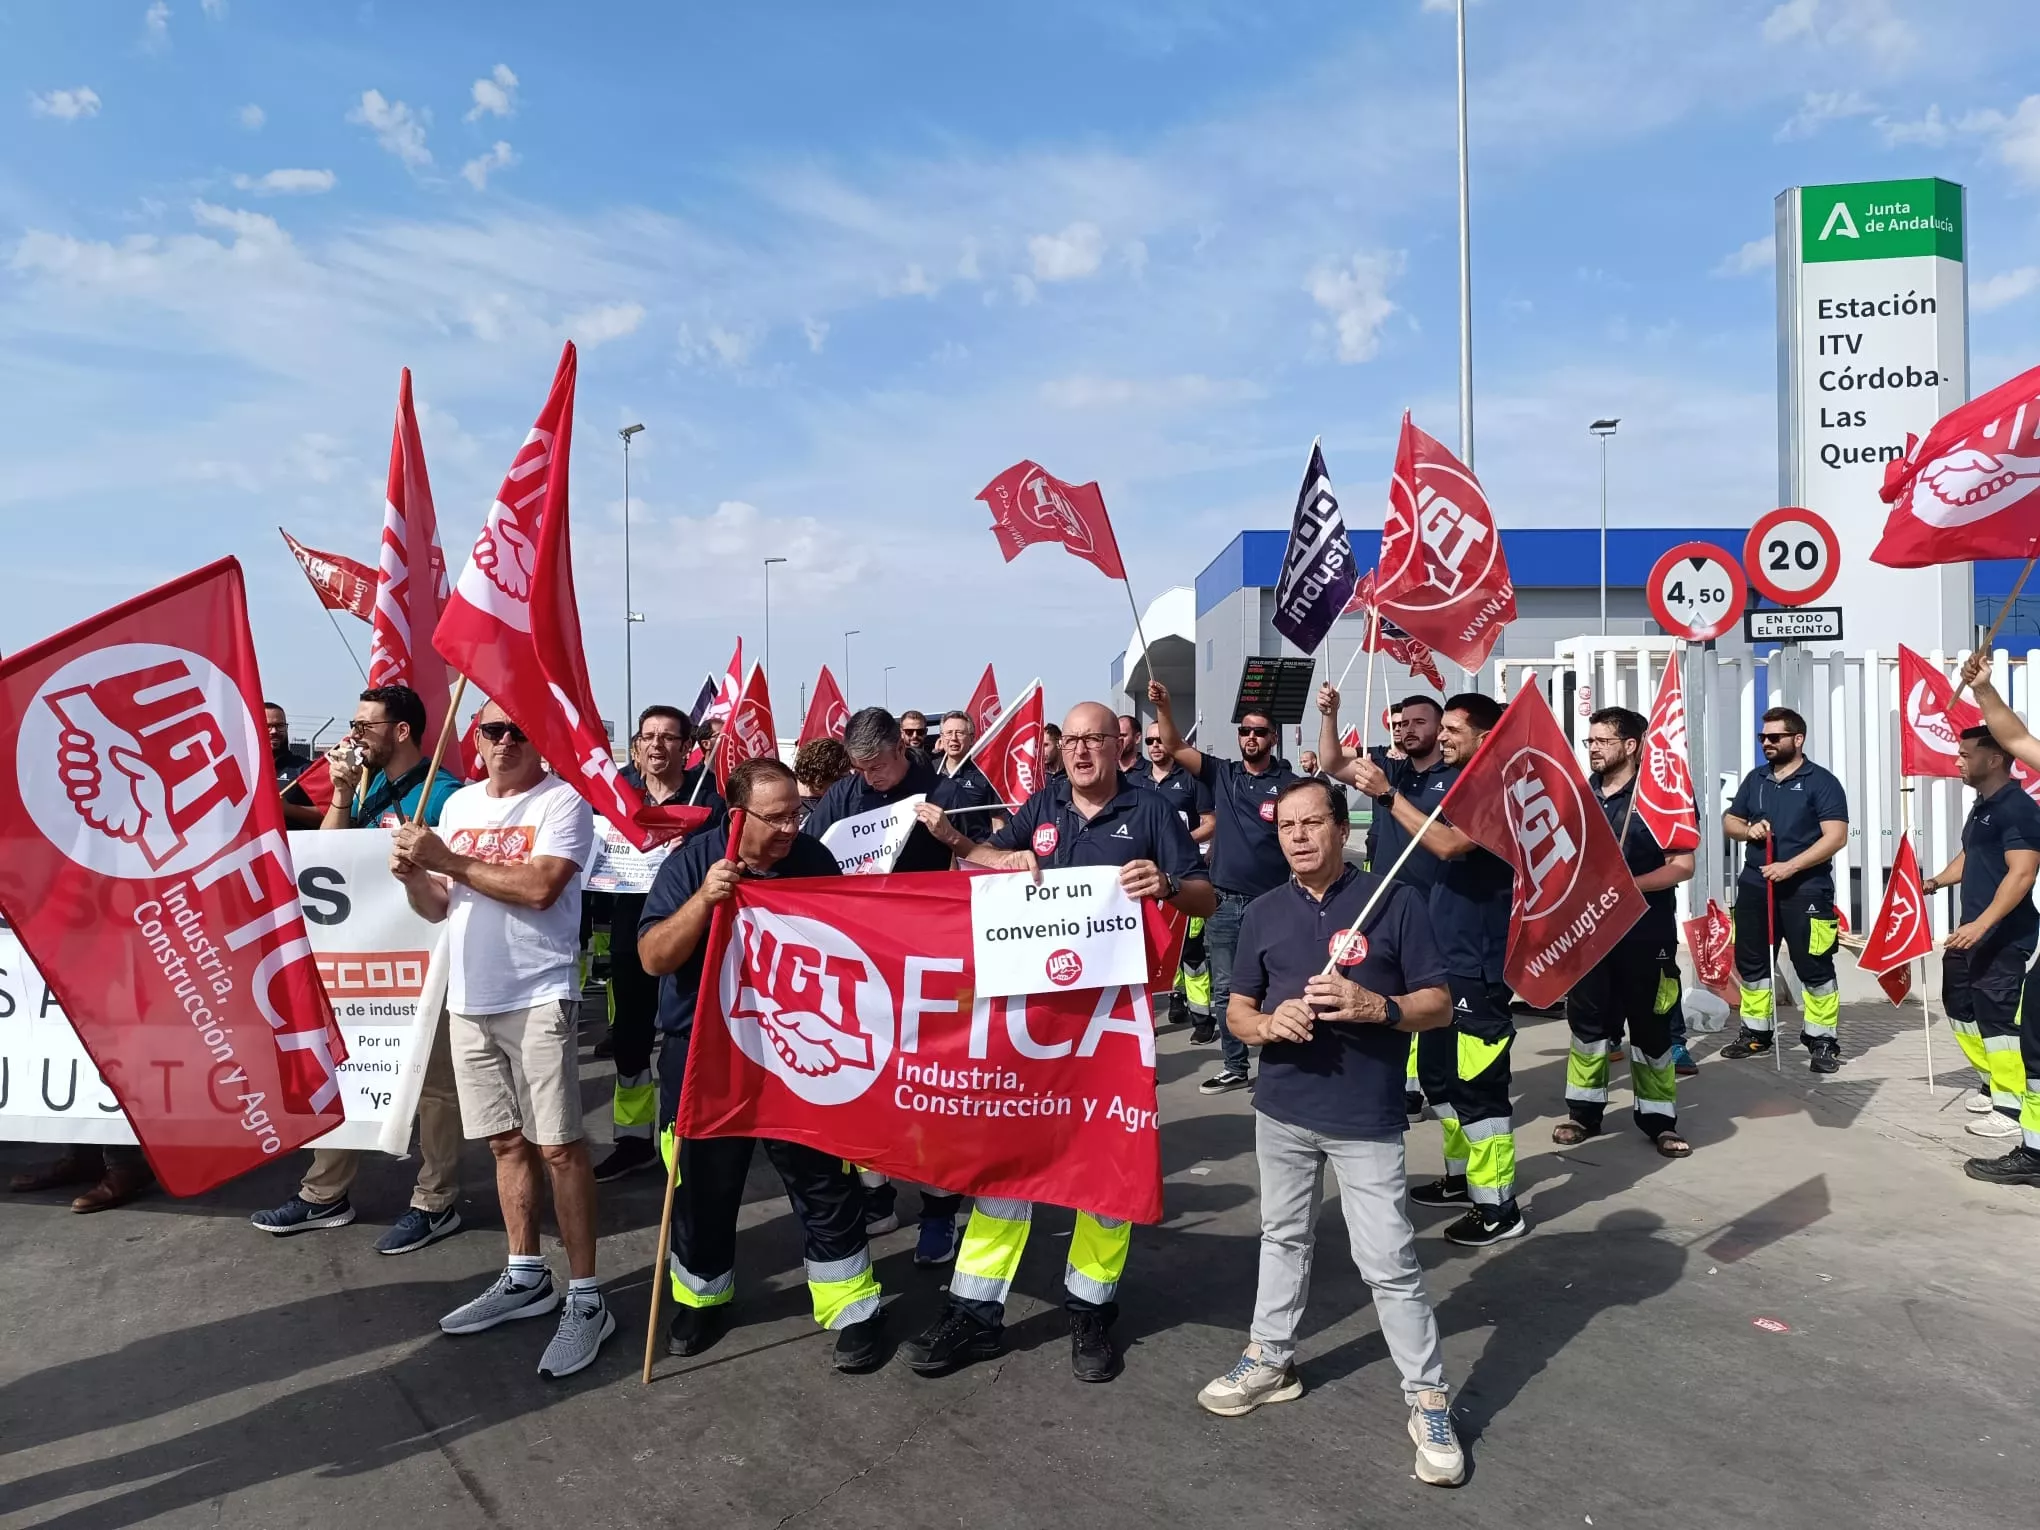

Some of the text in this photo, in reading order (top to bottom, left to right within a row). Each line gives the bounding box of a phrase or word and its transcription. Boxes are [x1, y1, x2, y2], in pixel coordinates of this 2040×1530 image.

[1865, 202, 1911, 217] Junta
[1865, 215, 1954, 233] de Andalucía
[1817, 291, 1938, 320] Estación
[1819, 333, 1863, 356] ITV
[1820, 407, 1867, 429] Las
[1768, 540, 1819, 571] 20
[1667, 581, 1725, 609] 4,50
[1757, 624, 1833, 636] EL RECINTO
[1766, 614, 1824, 624] EN TODO
[92, 658, 248, 822] UGT
[851, 815, 899, 838] Por un
[604, 843, 630, 855] VEIASA
[1025, 883, 1093, 902] Por un
[985, 914, 1137, 942] convenio justo
[1524, 885, 1620, 979] www.ugt.es
[161, 881, 235, 1005] Industria,
[1048, 952, 1078, 975] UGT
[740, 918, 869, 1035] UGT
[346, 1003, 366, 1017] de
[899, 955, 1157, 1069] FICA
[133, 900, 282, 1155] Construcción y Agro
[358, 1035, 401, 1047] Por un
[897, 1057, 1026, 1092] Industria,
[894, 1084, 1072, 1118] Construcción
[1082, 1097, 1098, 1122] y
